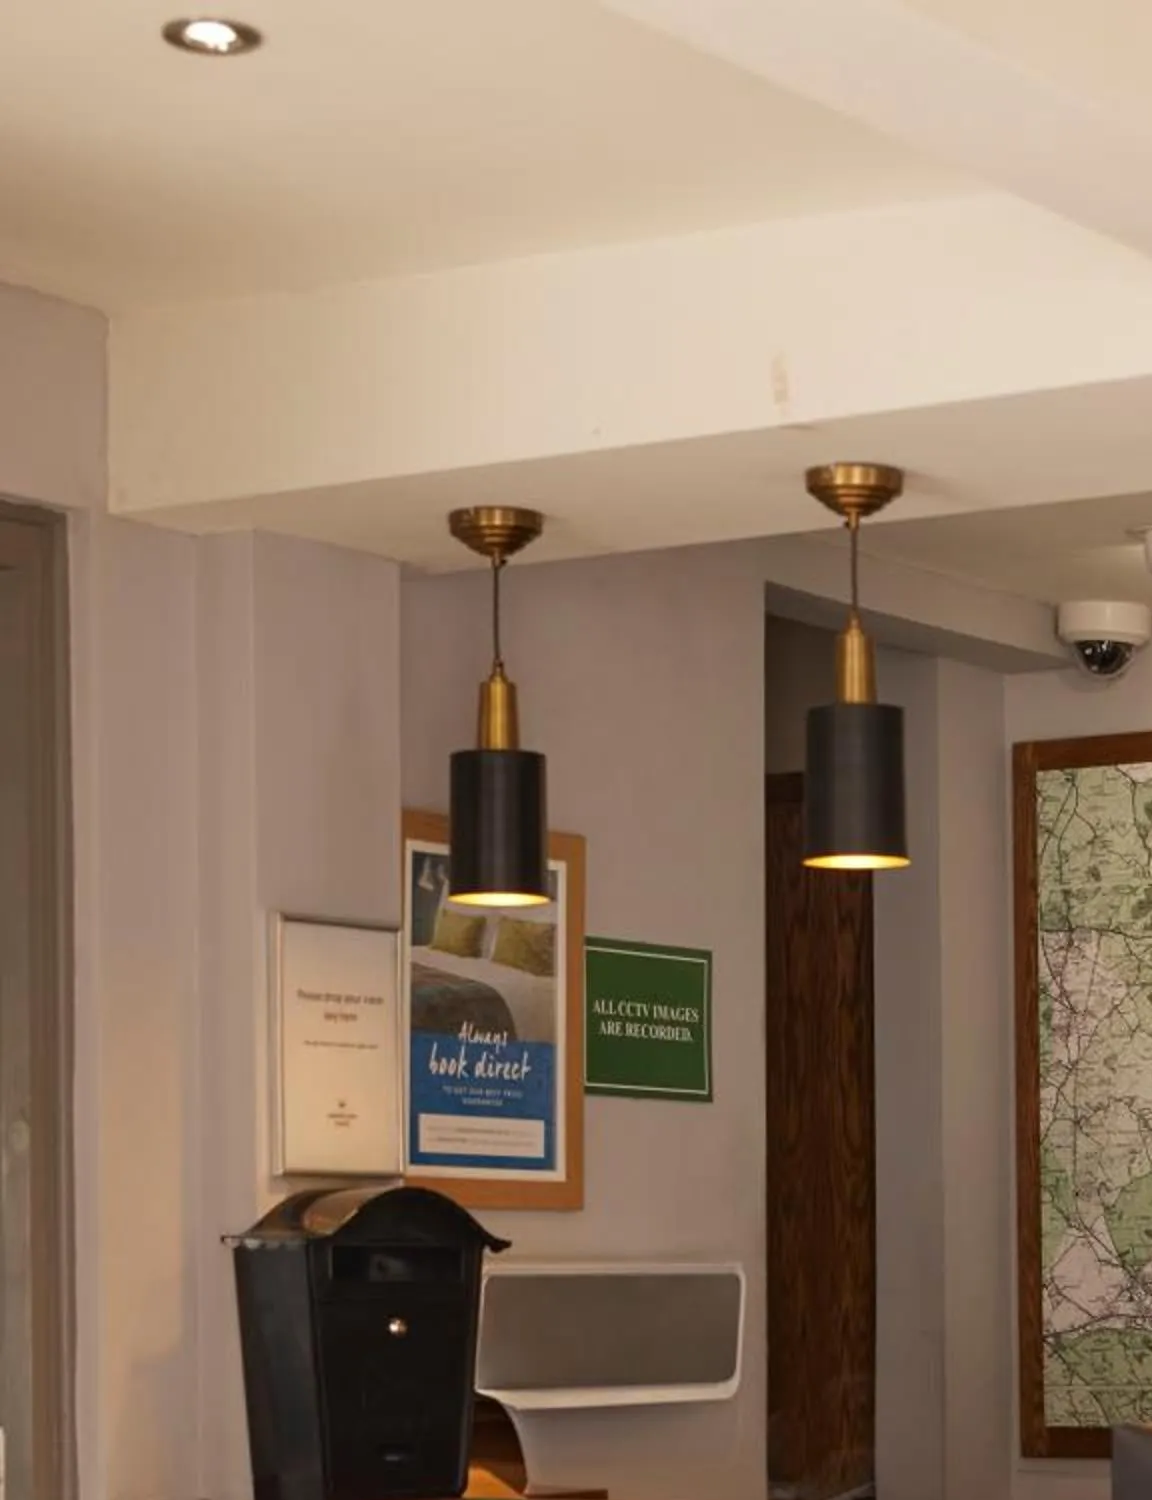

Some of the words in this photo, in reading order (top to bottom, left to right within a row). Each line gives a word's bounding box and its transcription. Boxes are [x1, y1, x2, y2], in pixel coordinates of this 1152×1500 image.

[592, 999, 616, 1015] ALL
[617, 1000, 650, 1018] CCTV
[653, 1004, 699, 1023] IMAGES
[458, 1020, 509, 1055] Always
[598, 1020, 623, 1036] ARE
[429, 1041, 469, 1080] book
[475, 1050, 532, 1082] direct
